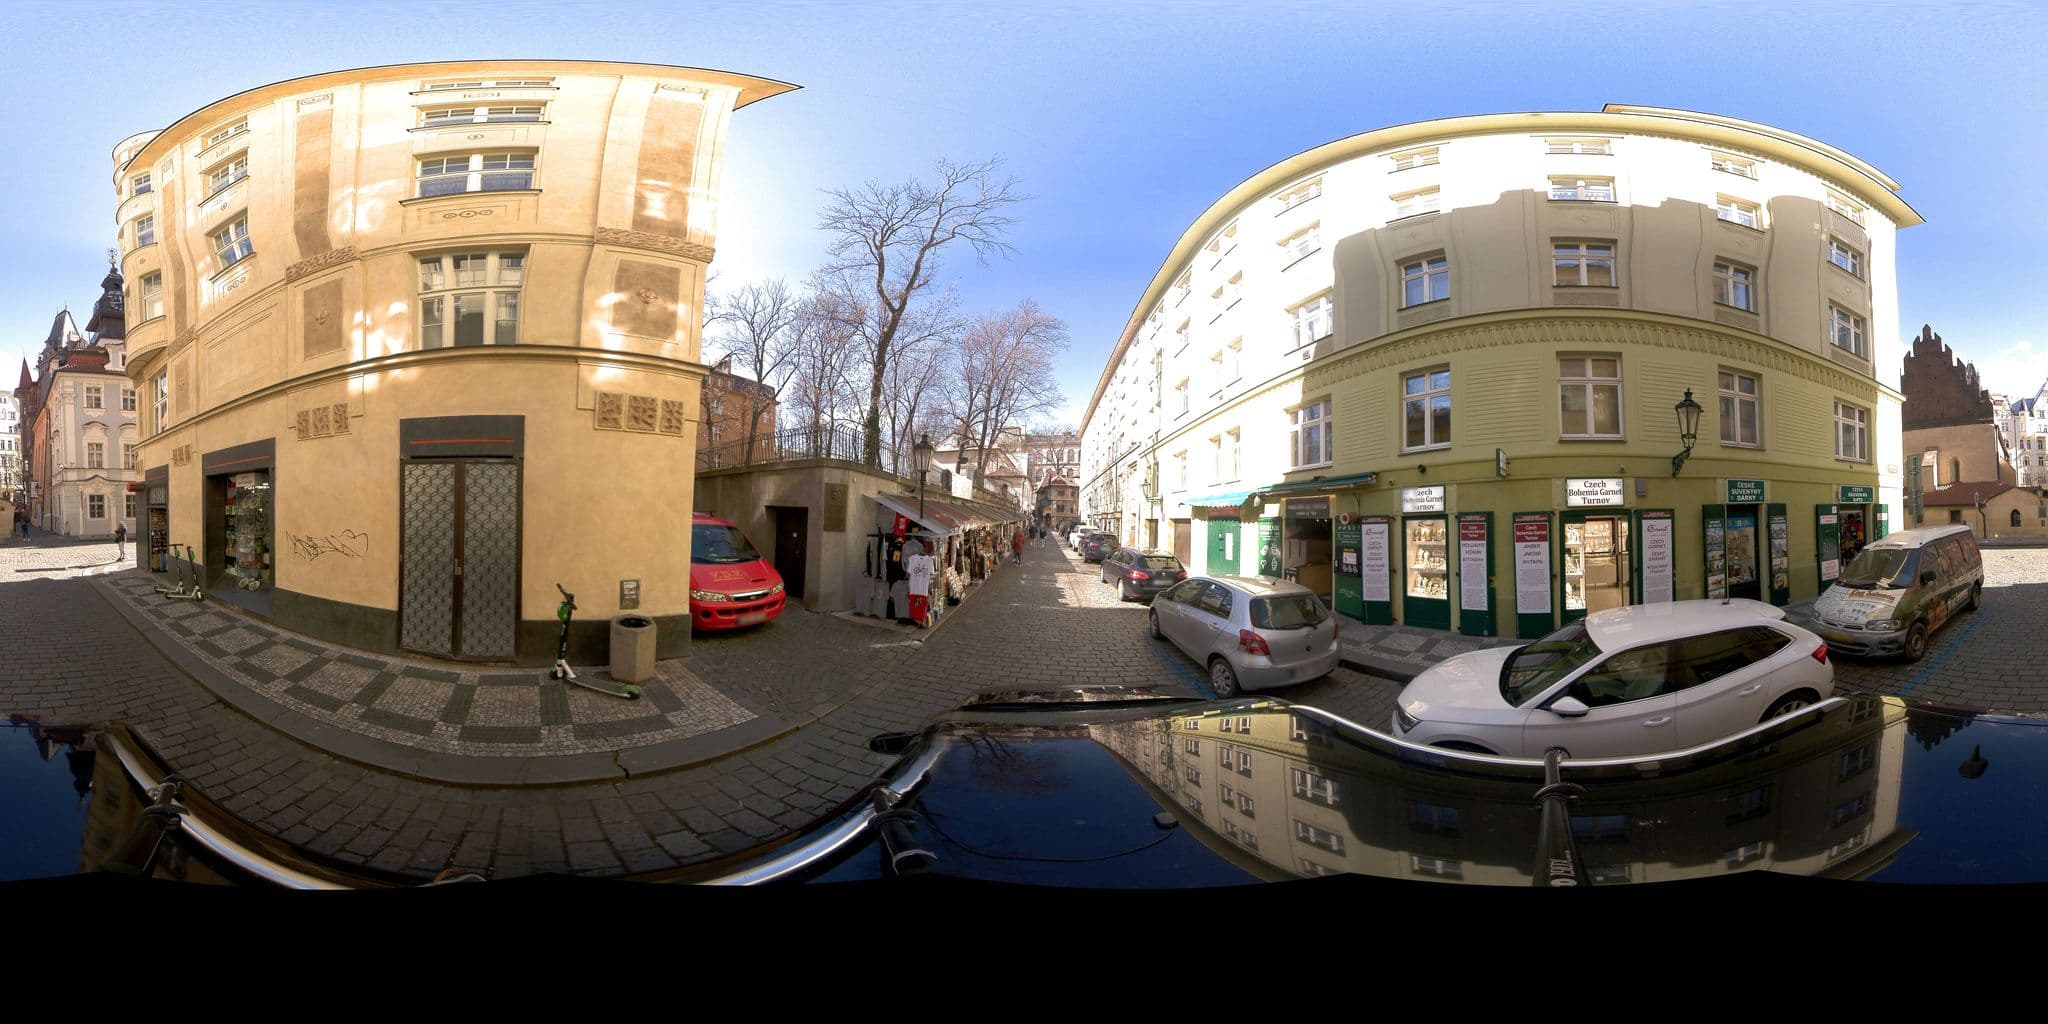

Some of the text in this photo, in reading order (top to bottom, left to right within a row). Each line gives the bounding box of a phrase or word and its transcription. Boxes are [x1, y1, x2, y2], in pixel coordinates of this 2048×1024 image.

[1583, 480, 1607, 488] Czech
[1568, 488, 1623, 497] Bohemia Garnet
[1426, 495, 1443, 503] Garnet
[1581, 497, 1611, 505] Turnov
